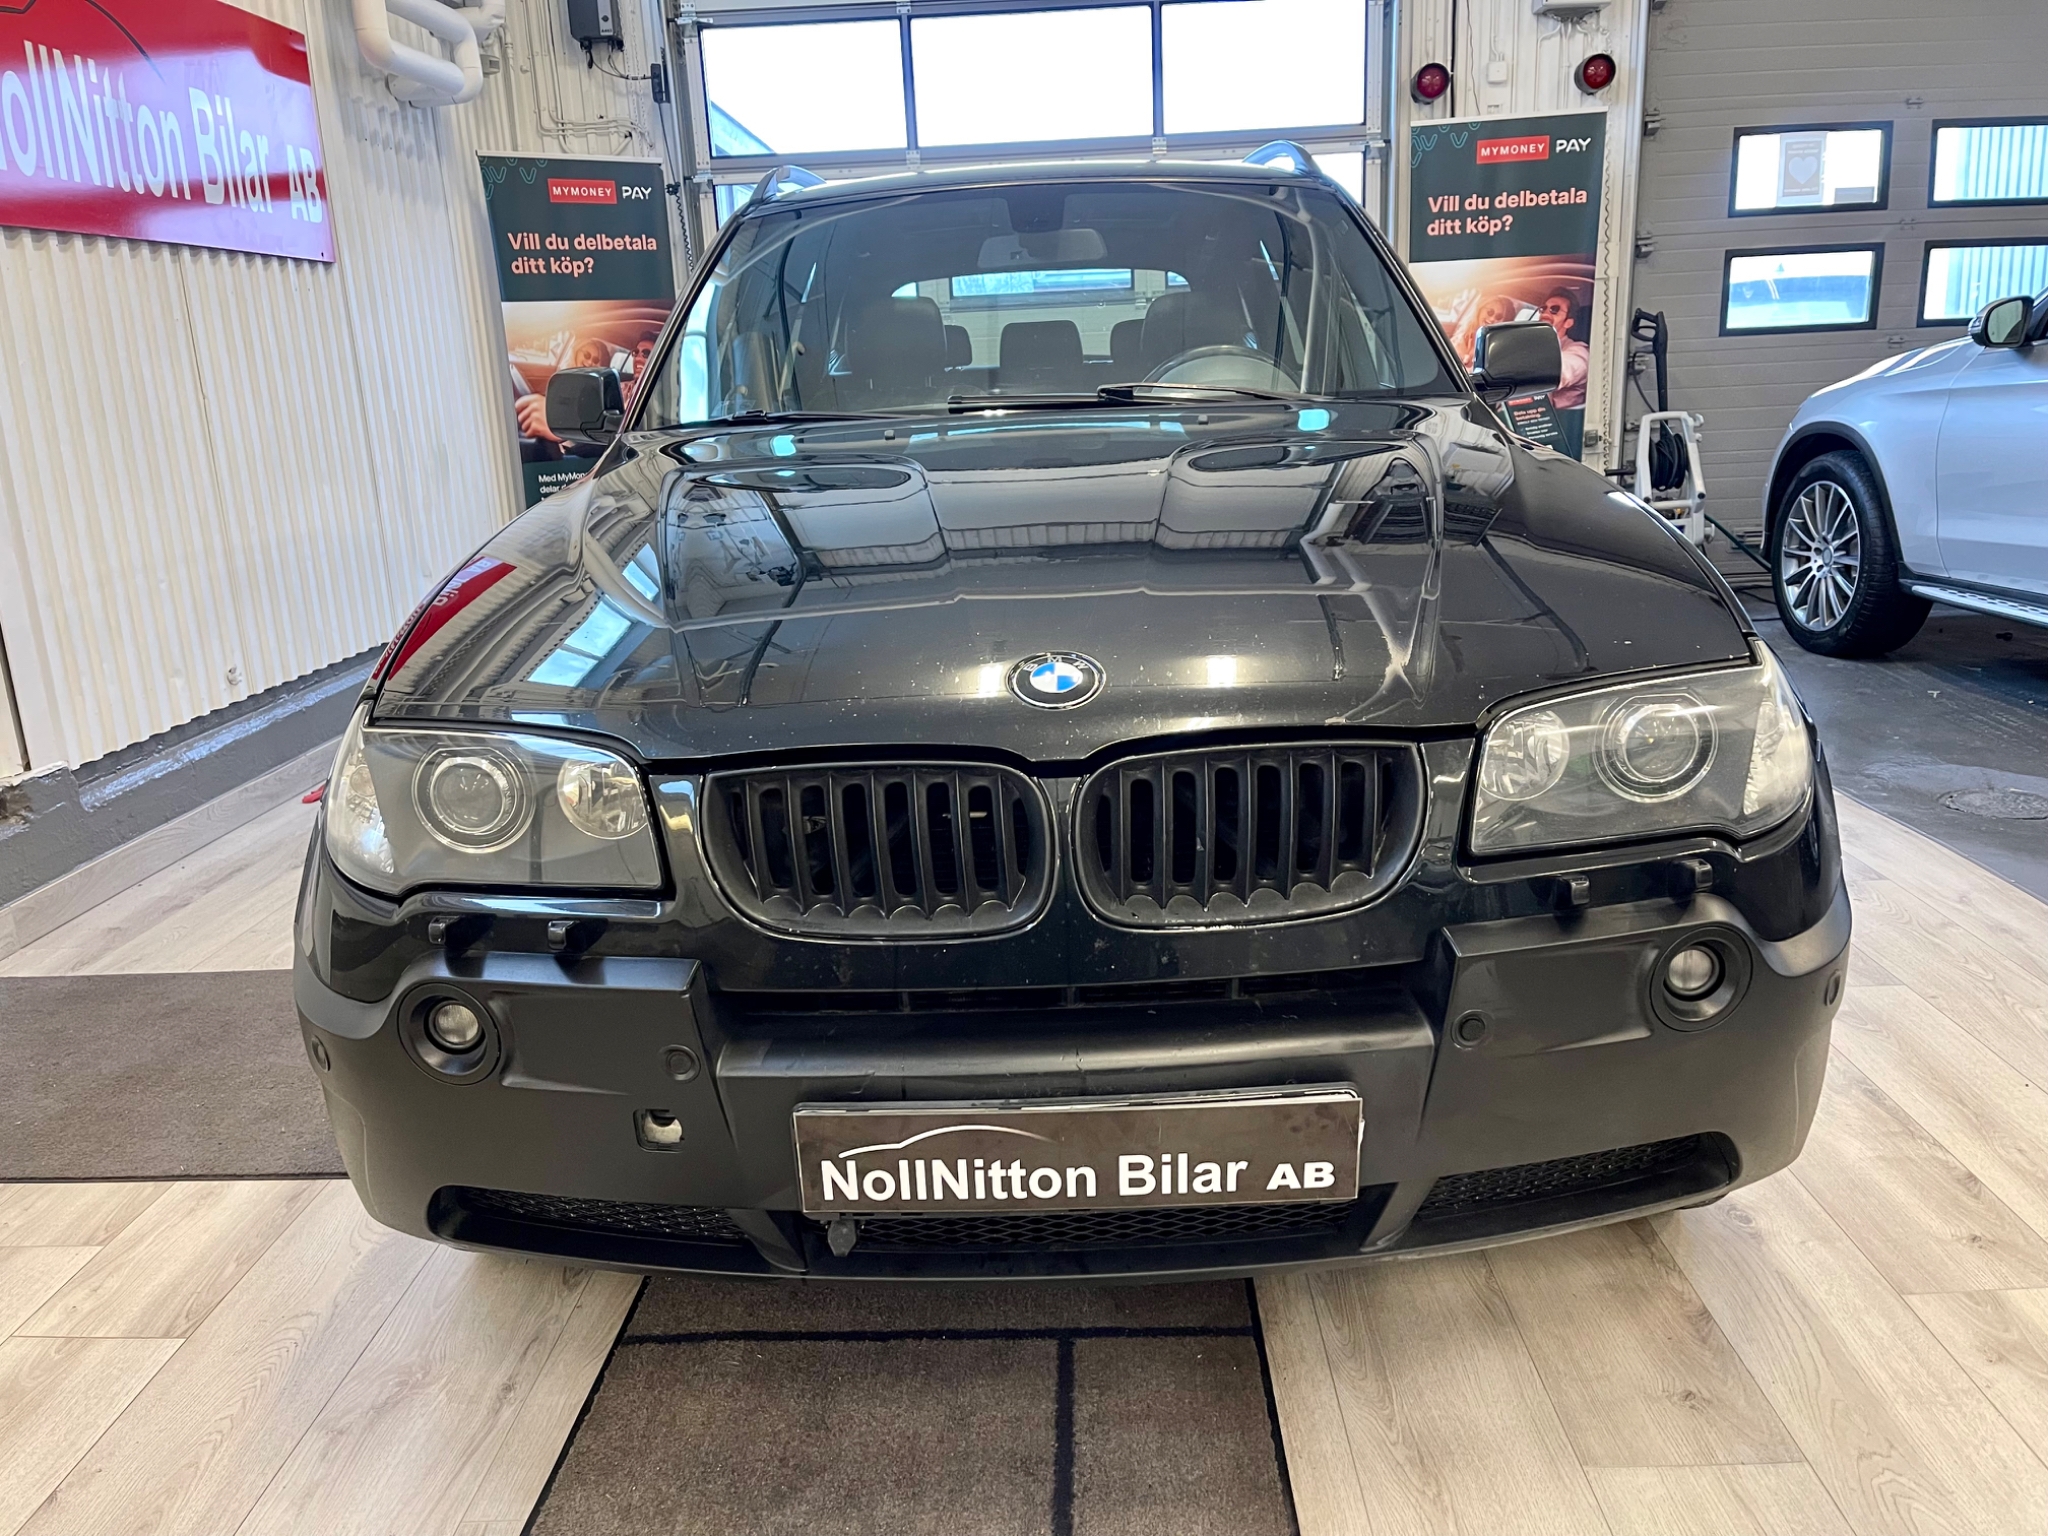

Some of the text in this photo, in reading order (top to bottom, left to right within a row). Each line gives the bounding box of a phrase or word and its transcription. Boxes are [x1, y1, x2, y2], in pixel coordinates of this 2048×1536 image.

[0, 40, 323, 223] ollNitton Bilar AB
[1480, 137, 1592, 157] MYMONEY PAY
[552, 186, 652, 200] MYMONEY PAY
[1427, 187, 1588, 213] Vill du delbetala
[1426, 214, 1514, 236] ditt köp?
[507, 232, 657, 250] Vill du delbetala
[511, 256, 594, 278] ditt köp?
[538, 473, 557, 483] Med
[1023, 655, 1089, 672] BMW
[820, 1152, 1336, 1202] NollNitton Bilar AB
